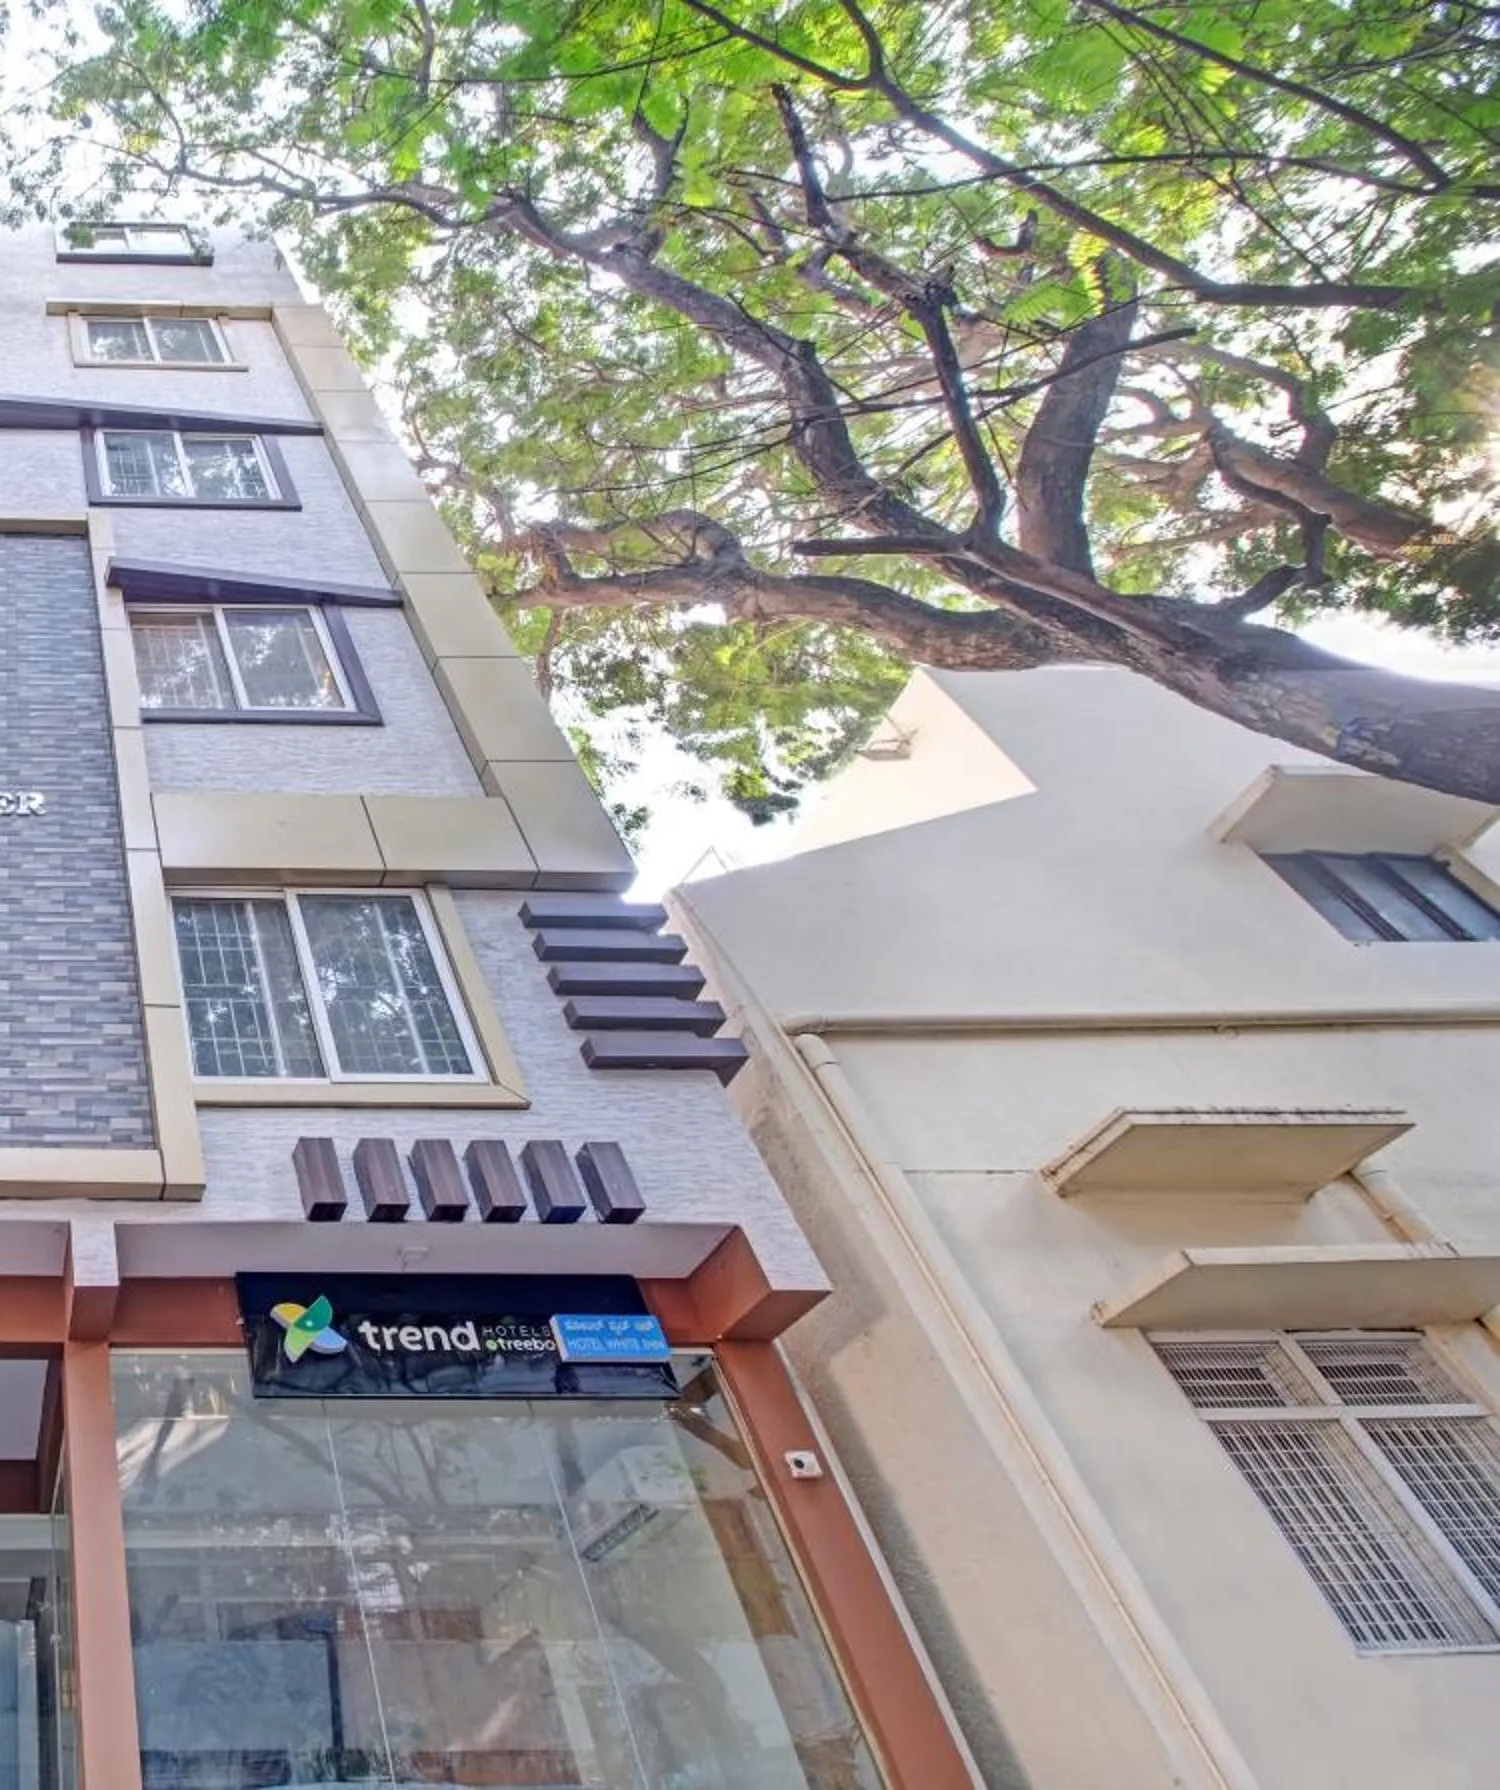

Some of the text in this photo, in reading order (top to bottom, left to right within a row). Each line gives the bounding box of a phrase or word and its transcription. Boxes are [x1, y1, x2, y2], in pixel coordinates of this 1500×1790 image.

[358, 1320, 481, 1352] trend
[482, 1325, 552, 1337] HOTELS
[497, 1337, 556, 1351] treebo
